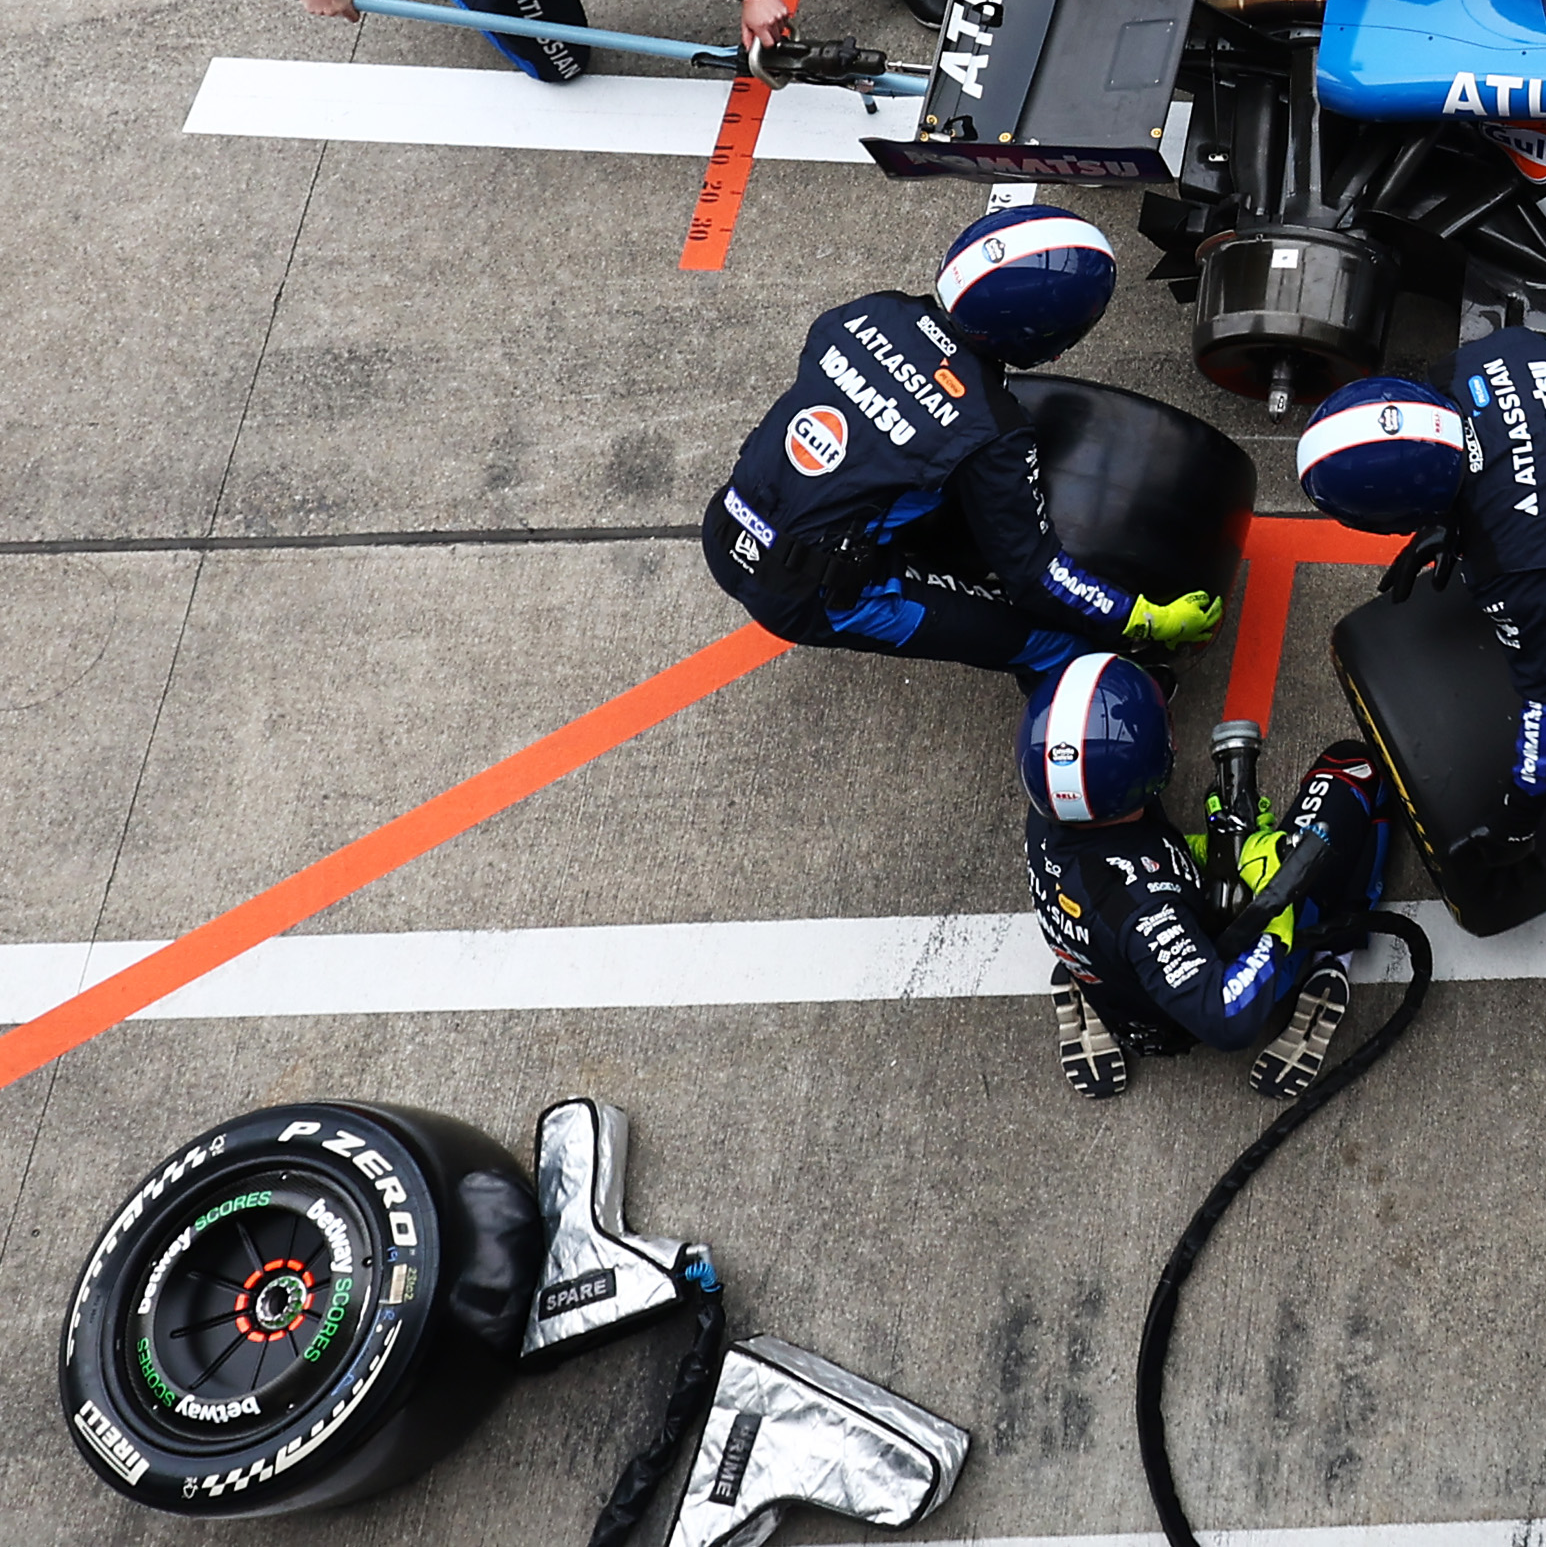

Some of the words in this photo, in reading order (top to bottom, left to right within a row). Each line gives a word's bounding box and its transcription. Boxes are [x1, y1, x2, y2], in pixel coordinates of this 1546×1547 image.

[699, 180, 722, 204] 20
[688, 217, 713, 242] 30
[916, 314, 960, 357] sparco
[818, 343, 918, 448] KOMATSU
[857, 324, 961, 428] ATLASSIAN
[792, 415, 844, 471] Gulf
[1483, 358, 1537, 486] ATLASSIAN
[723, 489, 775, 550] sparco
[1046, 556, 1115, 615] KOMATSU
[278, 1120, 320, 1144] P
[318, 1128, 420, 1249] ZERO
[134, 1223, 194, 1316] betway
[193, 1188, 274, 1233] SCORES
[305, 1198, 355, 1273] betway
[303, 1275, 355, 1364] SCORES
[546, 1279, 608, 1311] SPARE
[136, 1336, 178, 1409] SCORES
[173, 1392, 262, 1424] betway
[75, 1397, 146, 1487] PIRELLI
